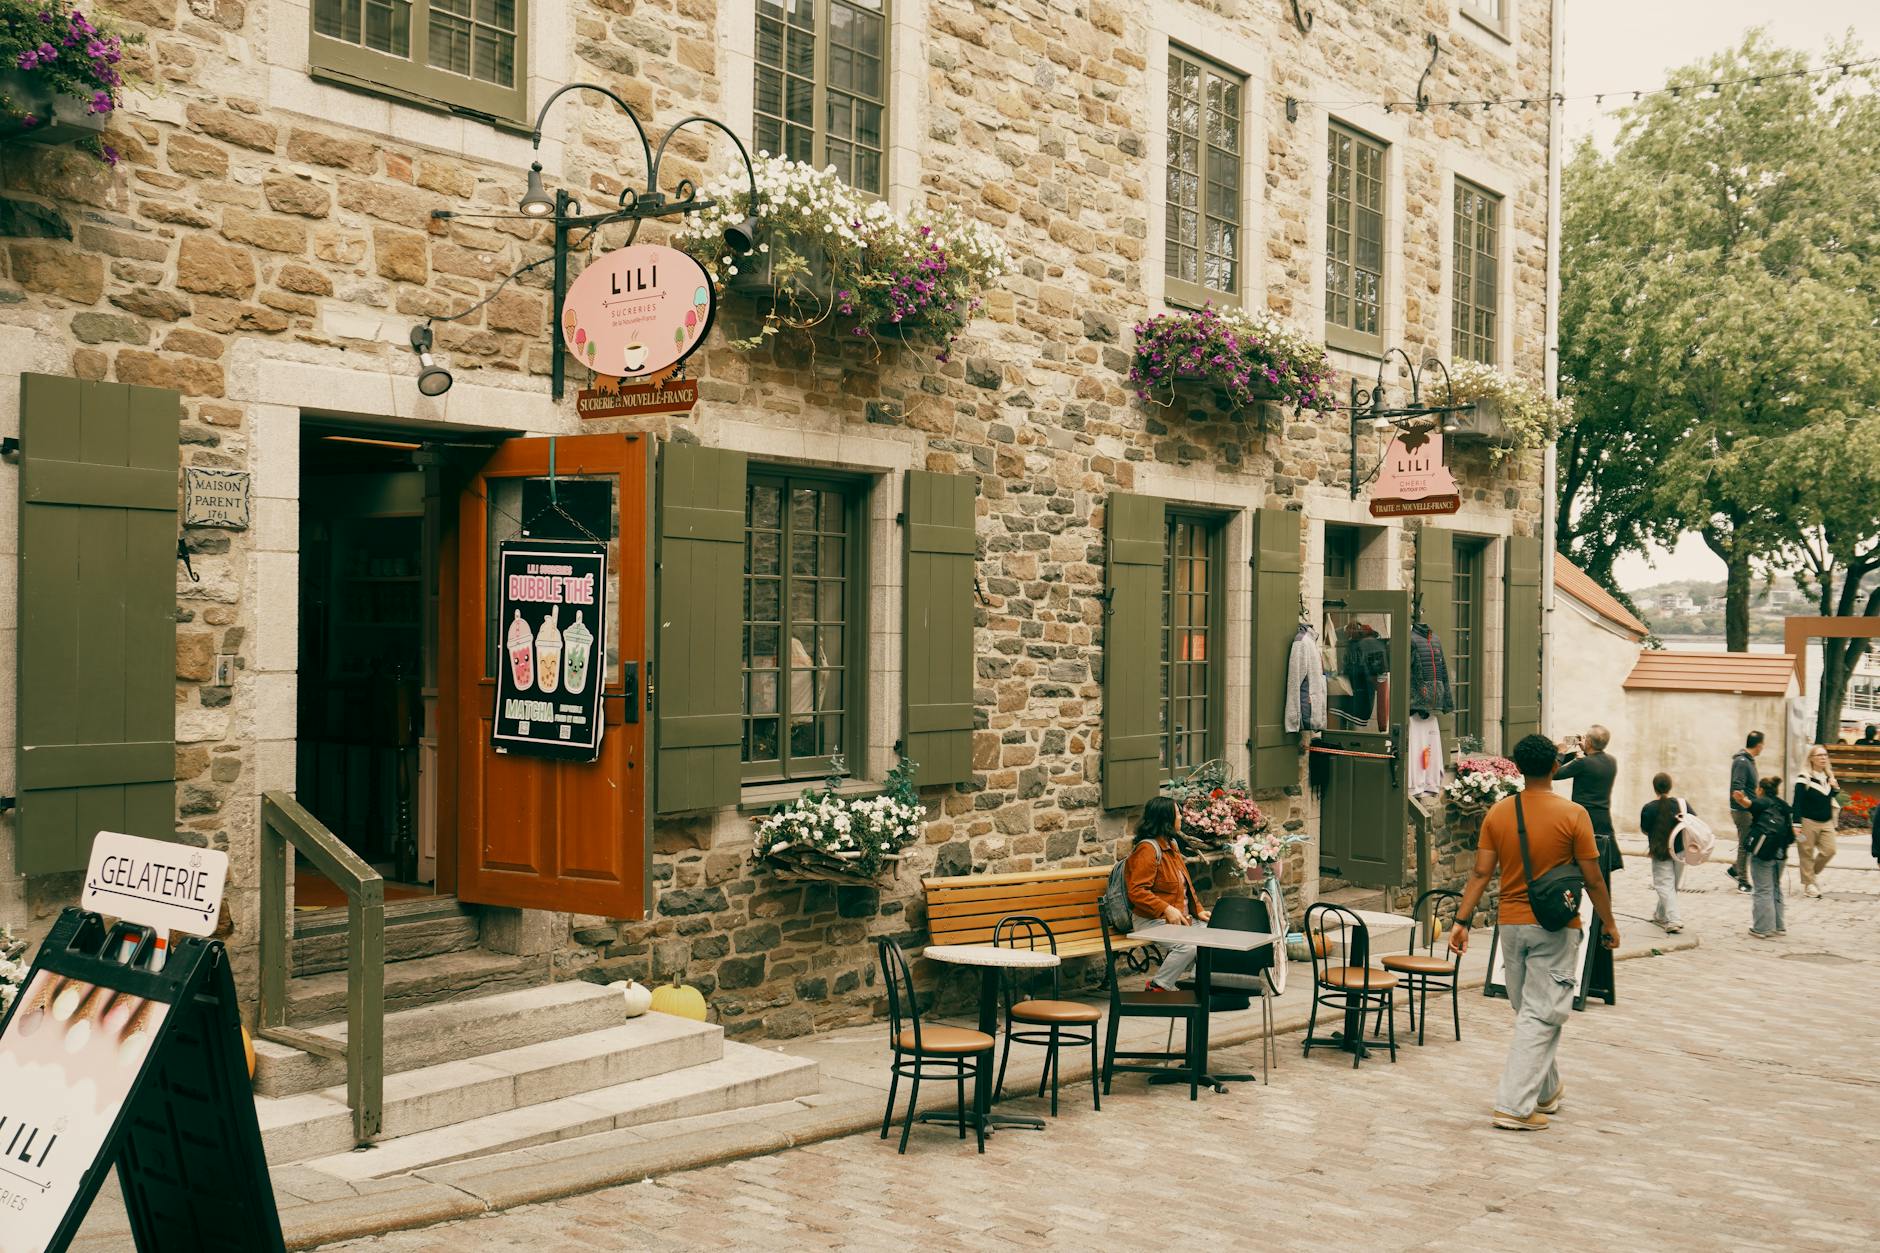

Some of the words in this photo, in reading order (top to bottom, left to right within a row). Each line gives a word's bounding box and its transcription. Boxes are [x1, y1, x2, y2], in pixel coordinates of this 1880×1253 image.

[612, 265, 656, 295] LILI
[611, 304, 656, 318] SUCRERIES
[580, 397, 614, 412] SUCRERIE
[623, 389, 694, 408] NOUVELLE-FRANCE
[1398, 459, 1429, 472] LILI
[195, 480, 241, 492] MAISON
[195, 495, 242, 508] PARENT
[1376, 505, 1395, 513] TRAITE
[1401, 501, 1454, 511] NOUVELLE-FRANCE
[208, 510, 227, 519] 1761
[509, 574, 563, 603] BUBBLE
[563, 573, 594, 605] THÉ
[505, 698, 554, 723] MATCHA
[101, 855, 208, 902] GELATERIE
